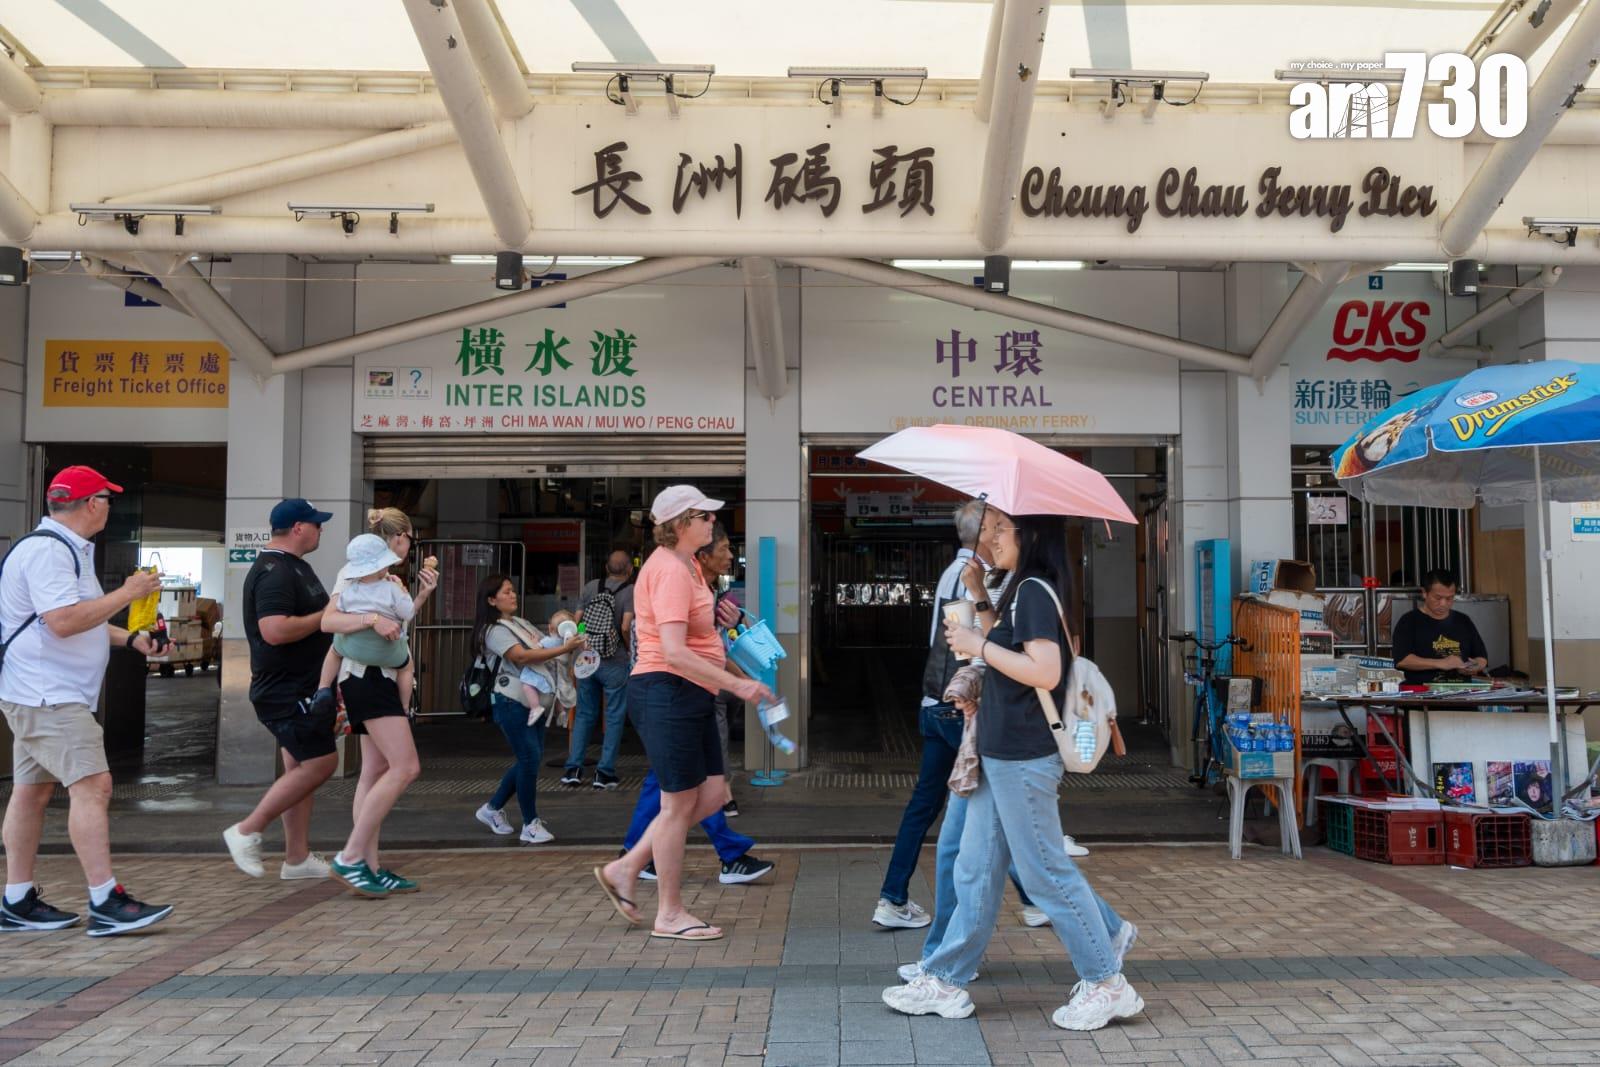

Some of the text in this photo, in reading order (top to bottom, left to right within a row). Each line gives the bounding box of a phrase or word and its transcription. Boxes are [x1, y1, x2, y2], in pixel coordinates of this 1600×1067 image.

[572, 141, 935, 220] 長洲碼頭
[1020, 166, 1437, 234] Cheung Chau Ferry Pier
[1371, 276, 1379, 288] 4
[1332, 300, 1431, 347] CKS
[57, 350, 221, 374] 貨票售票處
[455, 327, 638, 377] 橫水渡
[936, 329, 1043, 378] 中環
[53, 377, 226, 396] Freight Ticket Office
[446, 384, 647, 408] INTER ISLANDS
[932, 385, 1053, 408] CENTRAL
[1294, 379, 1392, 410] 新渡輪
[1295, 411, 1377, 425] SUN FERR
[1449, 372, 1577, 441] Drumstick
[501, 415, 524, 428] CHI
[528, 416, 548, 428] MA
[552, 416, 584, 428] WAN
[595, 416, 619, 428] MUI
[623, 416, 646, 429] WO
[657, 416, 693, 429] PENG
[697, 417, 735, 430] CHAU
[965, 415, 1037, 428] ORDINARY
[1316, 503, 1338, 520] 25
